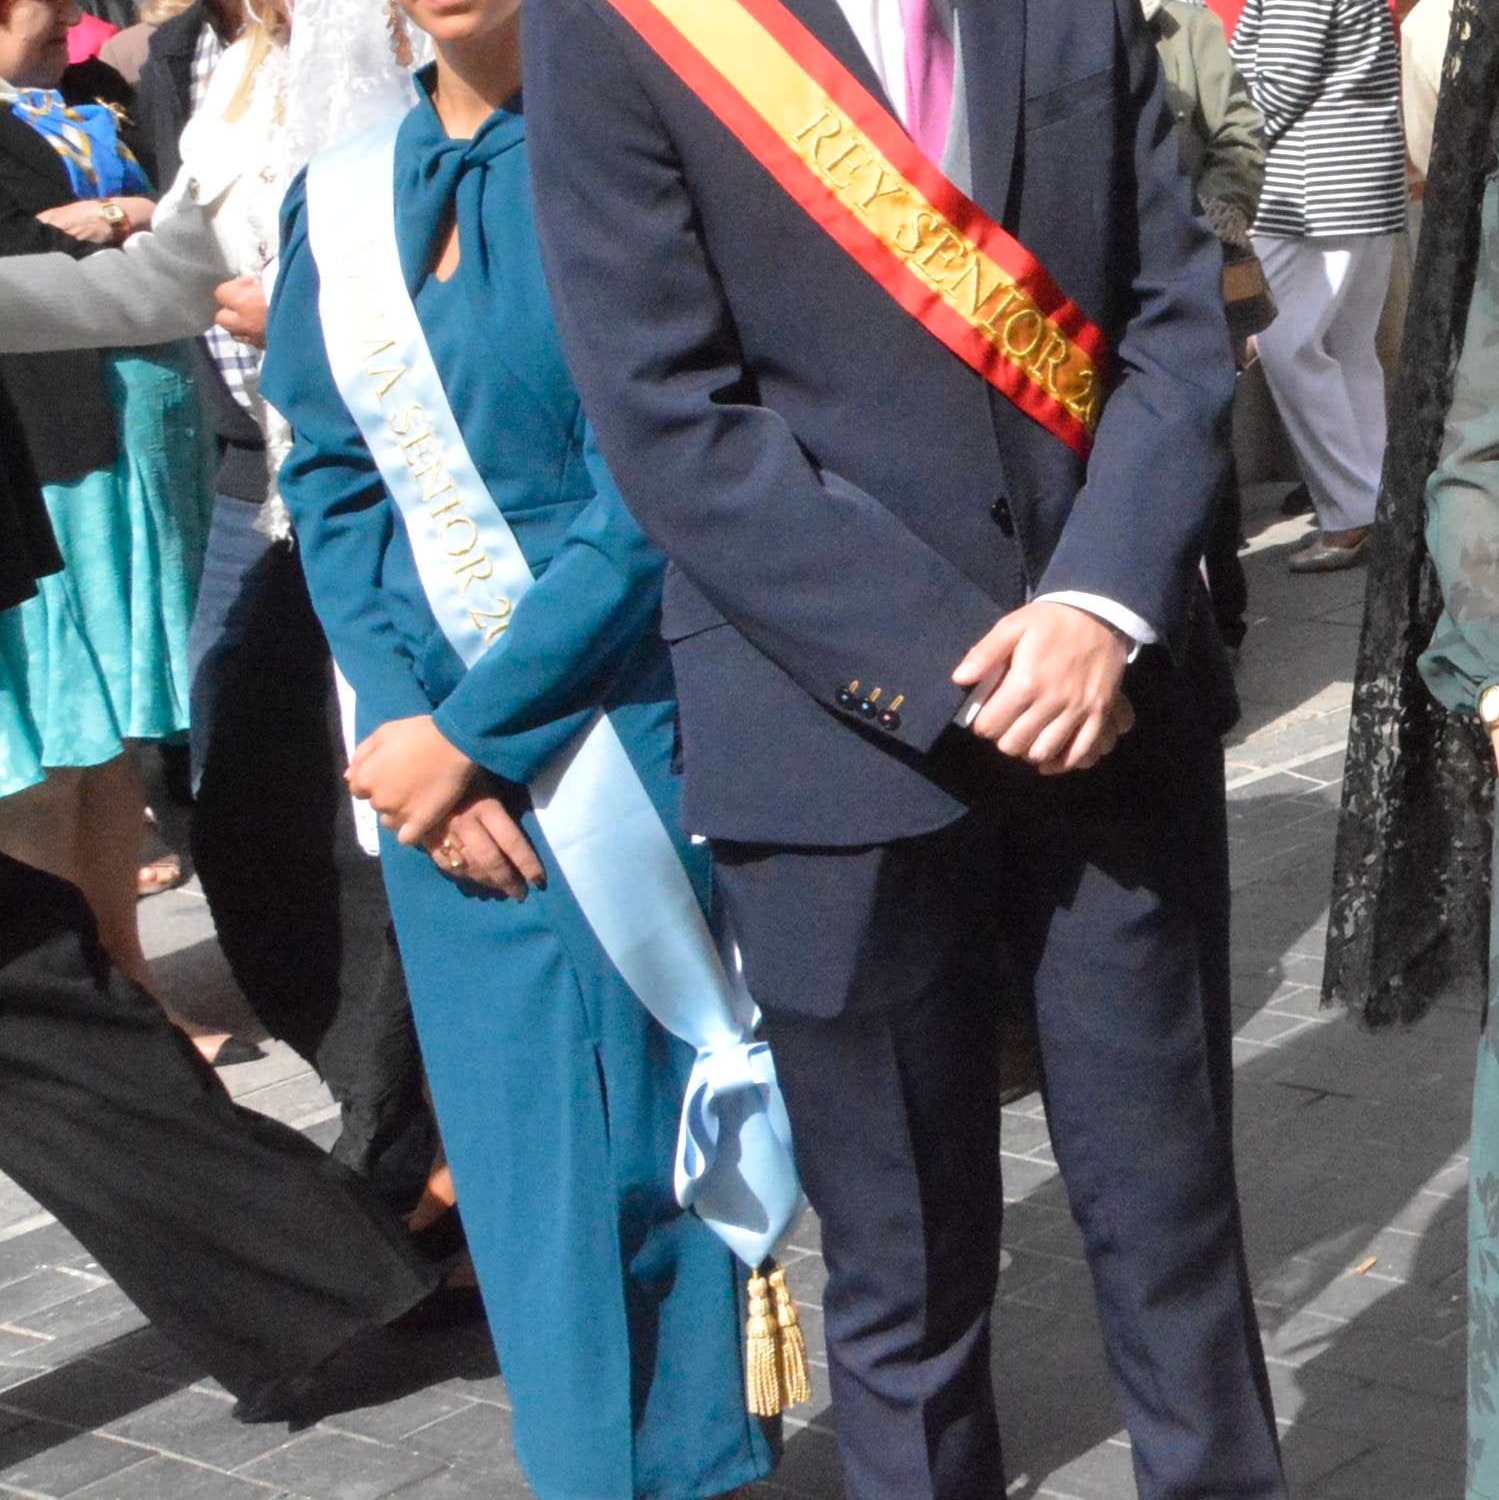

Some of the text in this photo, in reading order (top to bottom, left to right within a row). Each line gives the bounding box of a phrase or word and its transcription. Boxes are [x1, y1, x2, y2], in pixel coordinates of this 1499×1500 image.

[791, 107, 908, 215] REY
[896, 208, 1067, 400] SENIOR
[387, 402, 497, 598] SENIOR
